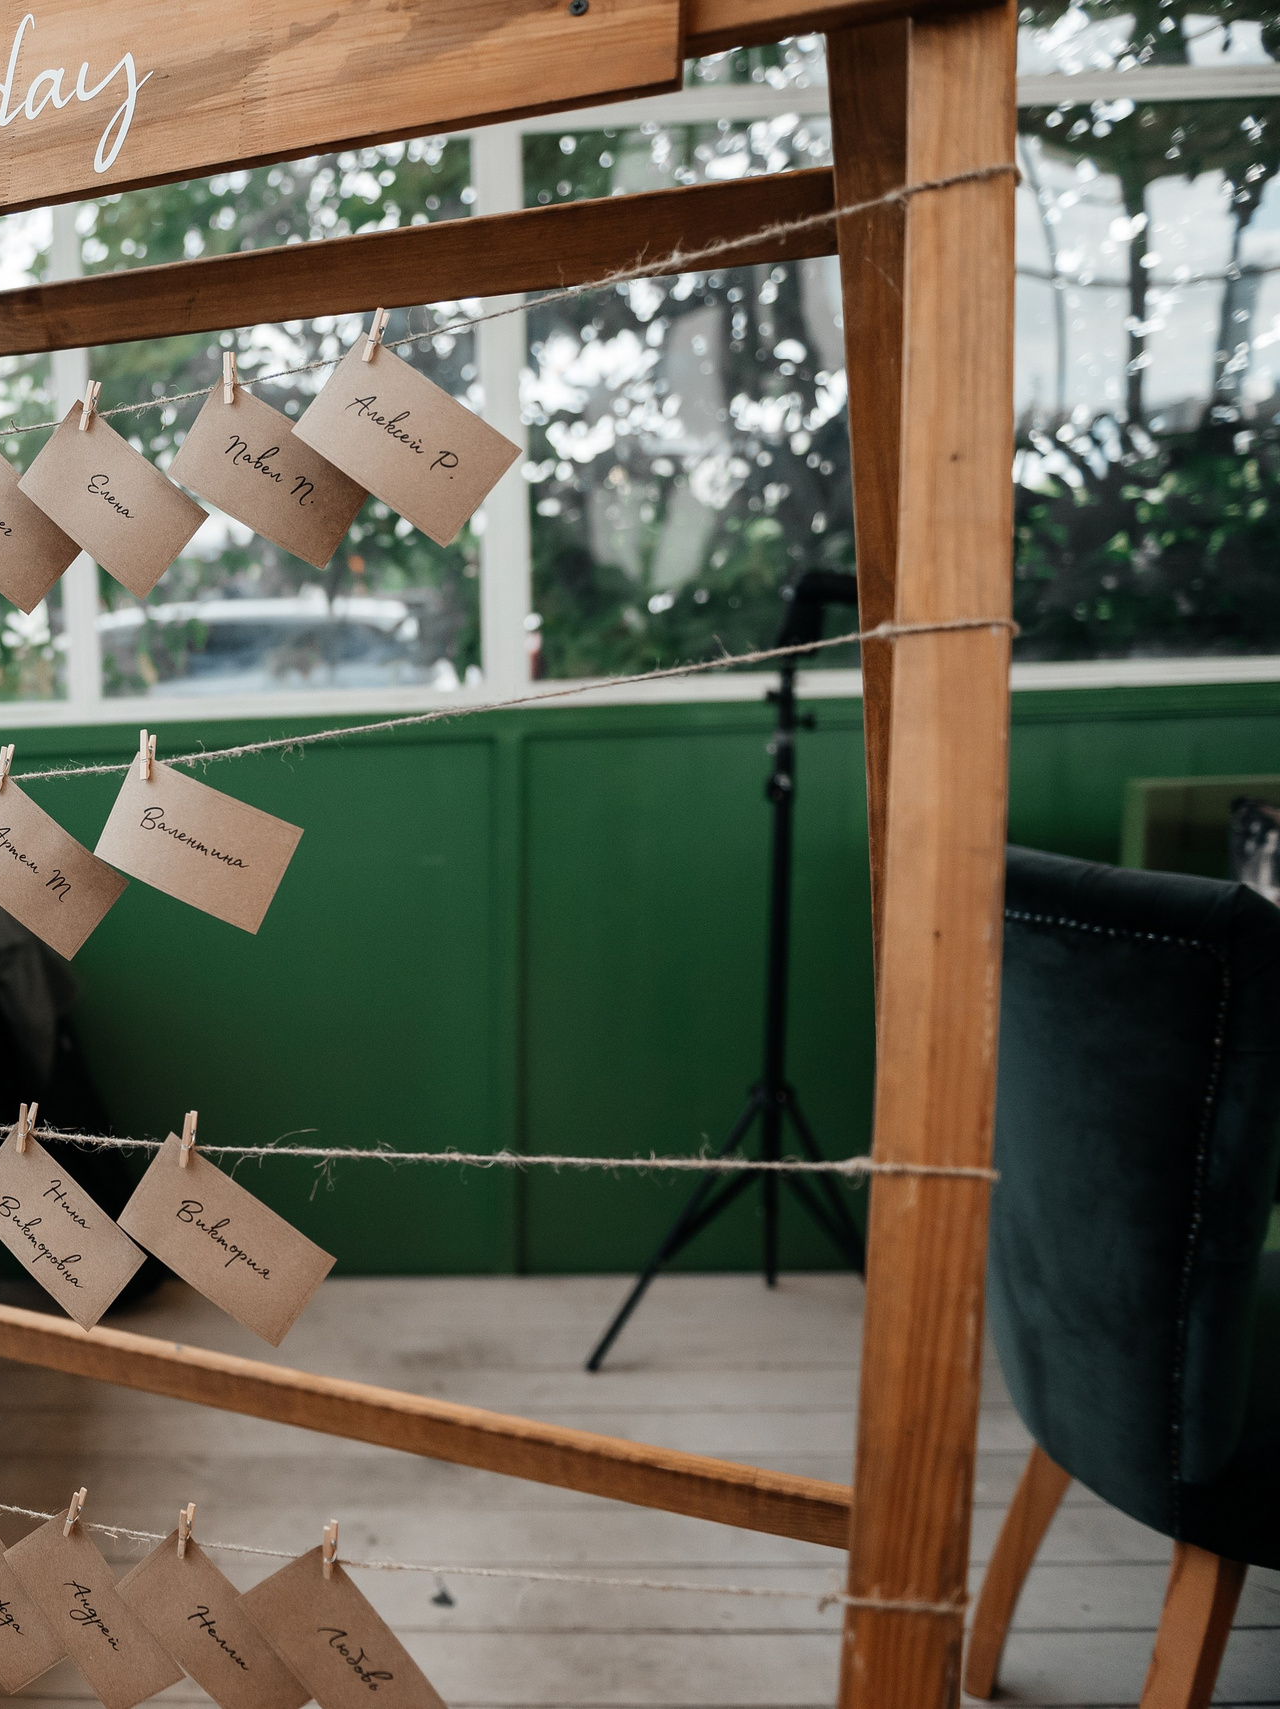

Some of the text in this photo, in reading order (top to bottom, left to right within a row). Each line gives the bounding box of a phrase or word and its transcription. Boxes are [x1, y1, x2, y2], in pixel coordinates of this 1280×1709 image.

[345, 396, 425, 455] Алексей
[224, 435, 283, 483] Павел
[87, 474, 135, 520] Елена
[139, 806, 250, 870] Валентина
[43, 1180, 91, 1230] Нина
[176, 1200, 271, 1281] Виктория
[63, 1580, 119, 1652] Андрей
[187, 1605, 249, 1671] Нелли
[317, 1626, 394, 1691] Любовь
